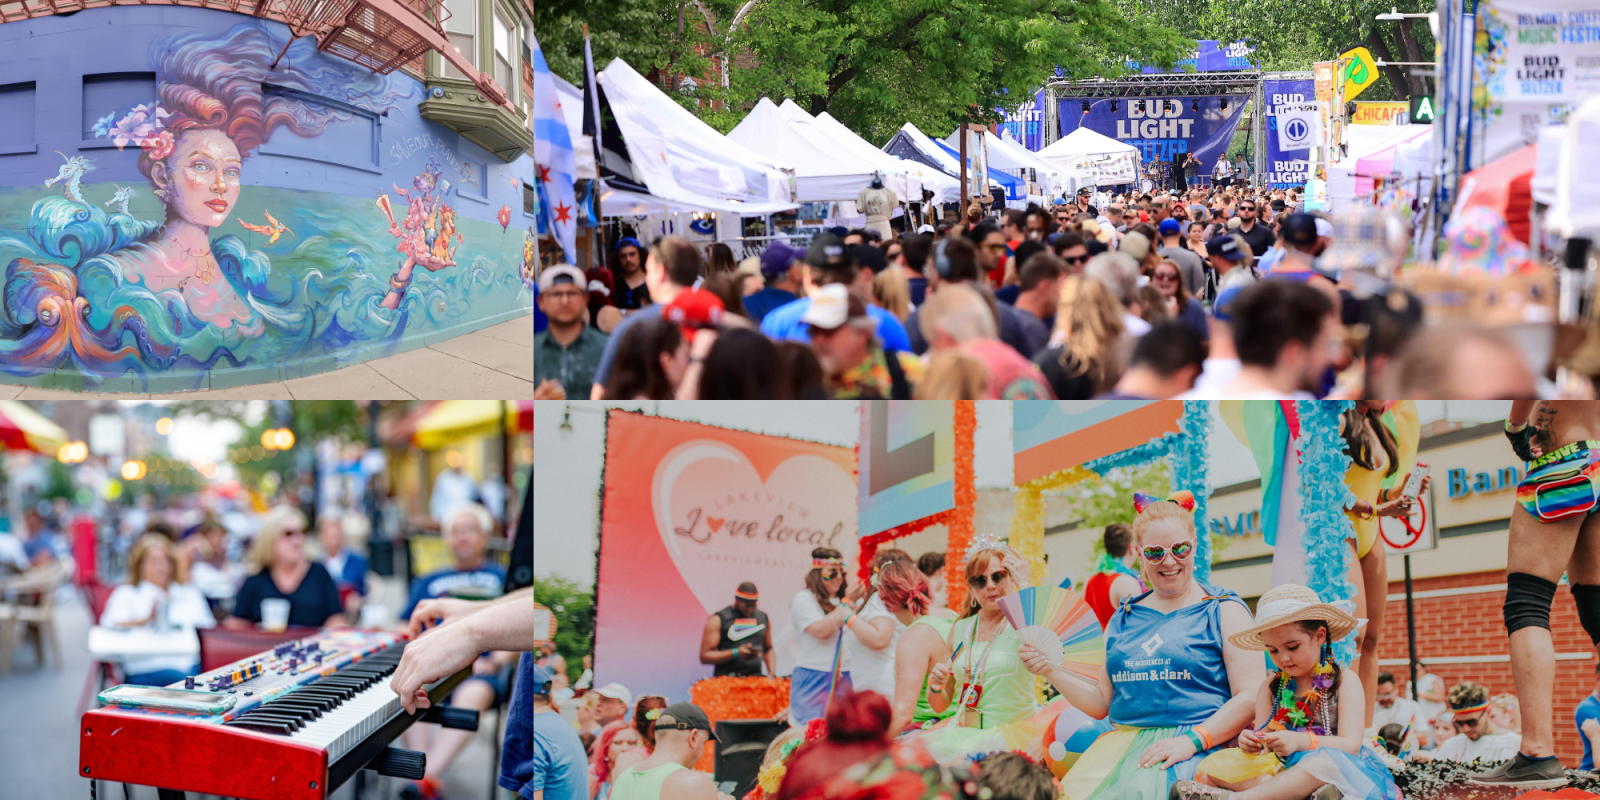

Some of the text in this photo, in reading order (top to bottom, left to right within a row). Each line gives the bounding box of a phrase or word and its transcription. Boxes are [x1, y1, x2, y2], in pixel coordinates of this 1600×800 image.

[1518, 27, 1557, 44] MUSIC
[1230, 42, 1247, 50] BU
[1229, 57, 1250, 66] SELTZE
[1524, 55, 1559, 67] BUD
[1517, 68, 1565, 79] LIGHT
[1272, 94, 1304, 105] BUD
[1127, 99, 1183, 118] BUD
[1416, 97, 1434, 120] A
[1117, 118, 1195, 138] LIGHT
[1275, 160, 1305, 171] BUD
[1448, 461, 1530, 498] Ban
[713, 491, 810, 519] LAKEVIEW
[765, 514, 843, 546] local
[1124, 660, 1134, 668] THE
[1135, 659, 1164, 667] RESIDENCES
